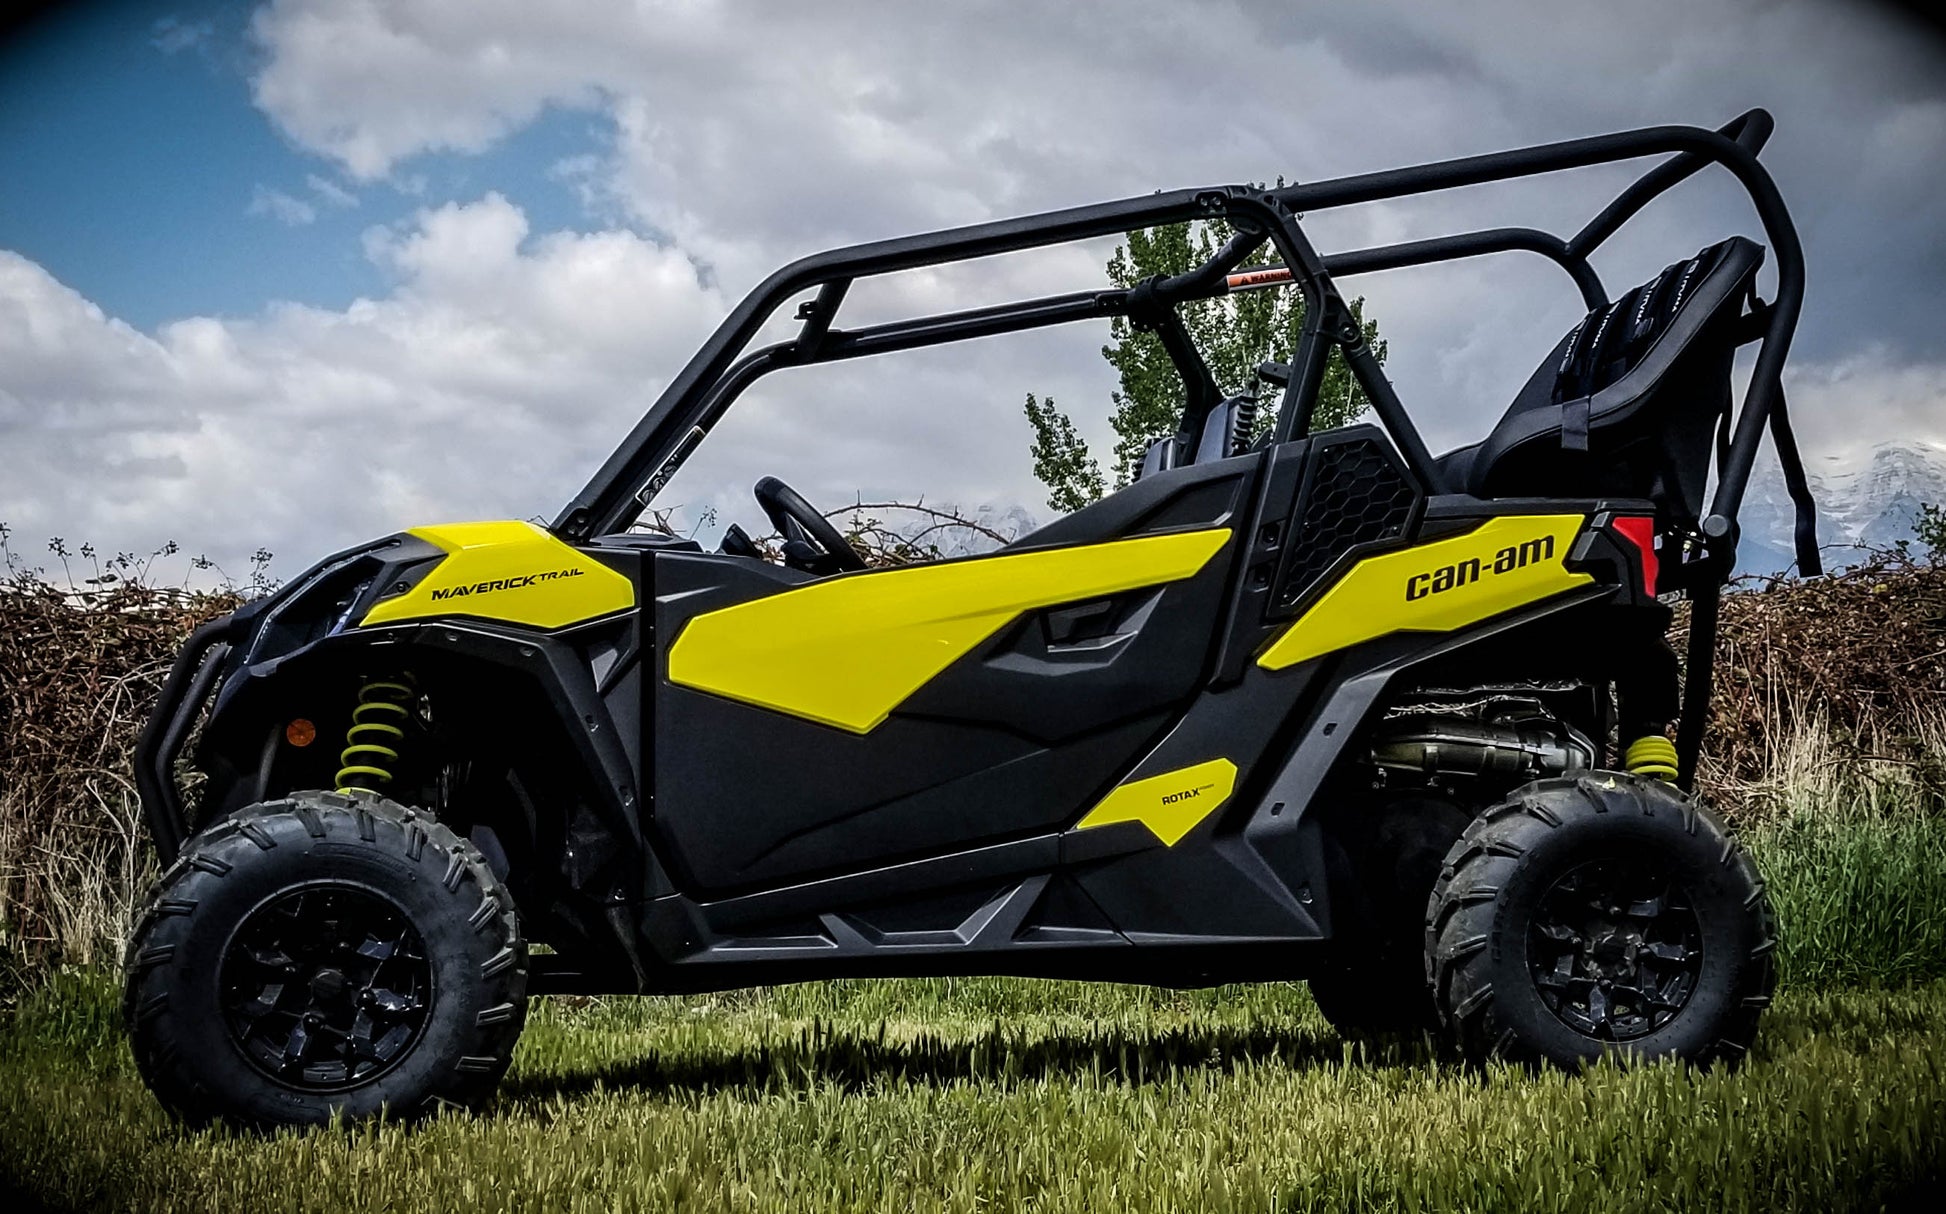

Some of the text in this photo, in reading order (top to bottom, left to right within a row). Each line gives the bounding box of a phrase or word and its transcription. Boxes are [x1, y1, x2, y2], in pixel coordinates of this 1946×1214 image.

[431, 568, 585, 601] MAVERICK TRAIL
[1406, 535, 1555, 602] can-am
[1162, 788, 1200, 805] ROTAX
